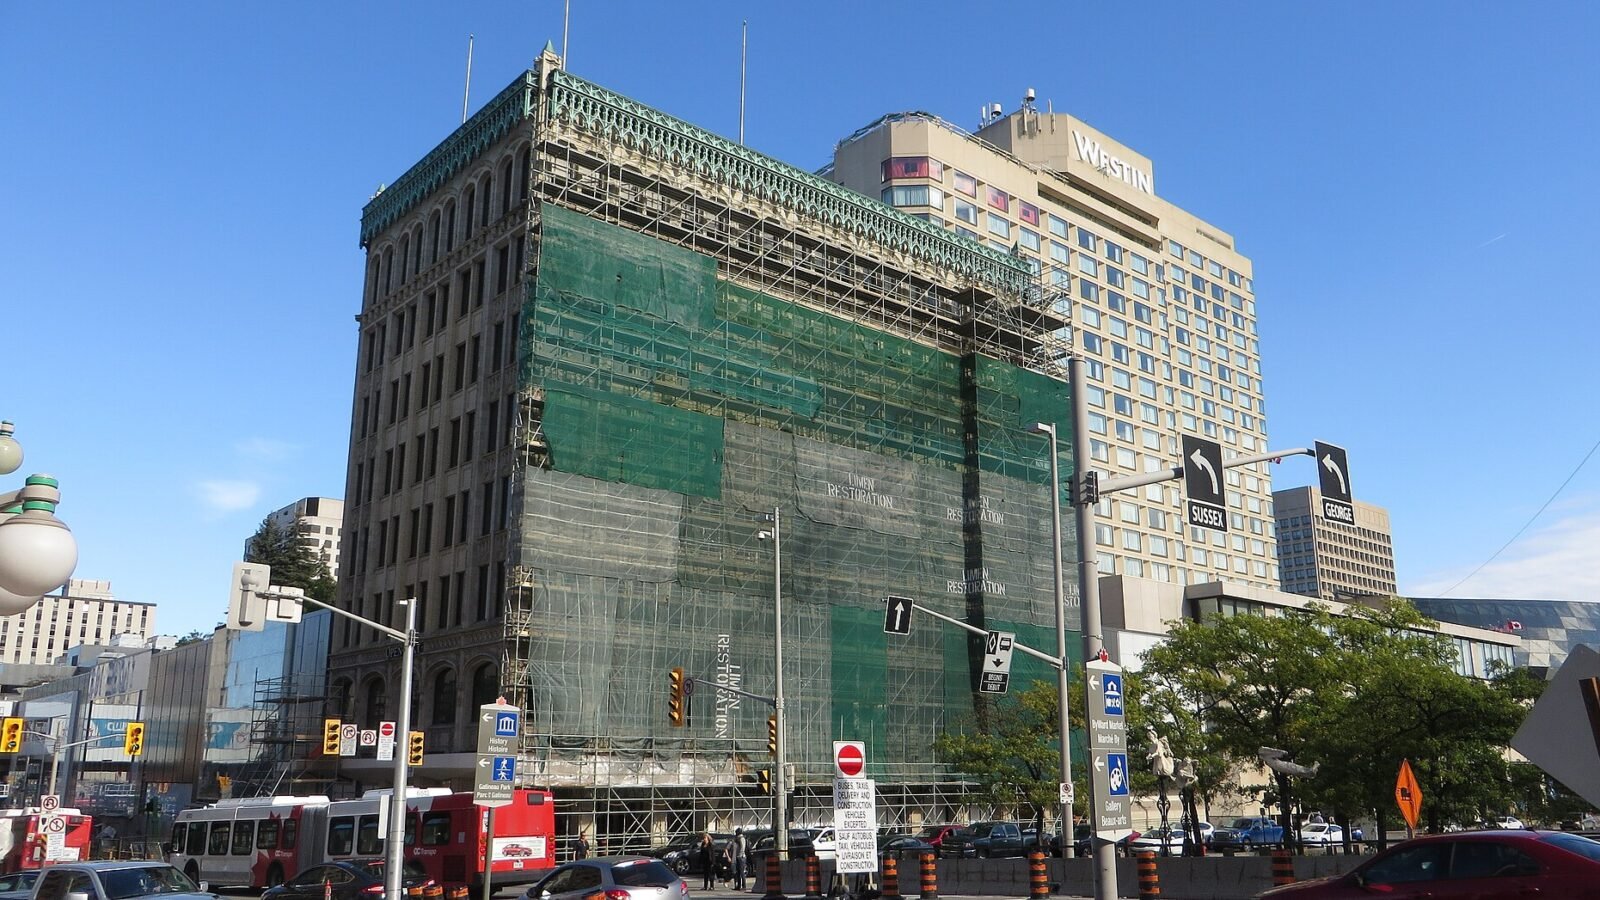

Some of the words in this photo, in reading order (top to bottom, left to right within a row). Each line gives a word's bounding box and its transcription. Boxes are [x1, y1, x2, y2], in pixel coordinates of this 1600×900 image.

[1072, 130, 1152, 195] WESTIN
[848, 472, 875, 492] LIMEN
[828, 483, 893, 509] RESTORATION
[1192, 505, 1224, 528] SUSSEX
[1325, 502, 1353, 522] GEORGE
[947, 579, 1006, 596] RESTORATION
[715, 634, 729, 738] RESTORATION
[1109, 719, 1124, 730] Market
[489, 737, 508, 746] History
[1114, 734, 1120, 746] By
[837, 791, 860, 800] DELIVERY
[860, 791, 871, 800] AND
[837, 801, 873, 810] CONSTRUCTION
[1104, 800, 1122, 813] Gallery
[844, 810, 867, 819] VEHICLES
[1101, 814, 1127, 827] Beaux-arts
[838, 832, 851, 841] SAUF
[841, 851, 865, 860] LIVRAISON
[866, 851, 872, 860] ET
[839, 860, 875, 870] CONSTRUCTION
